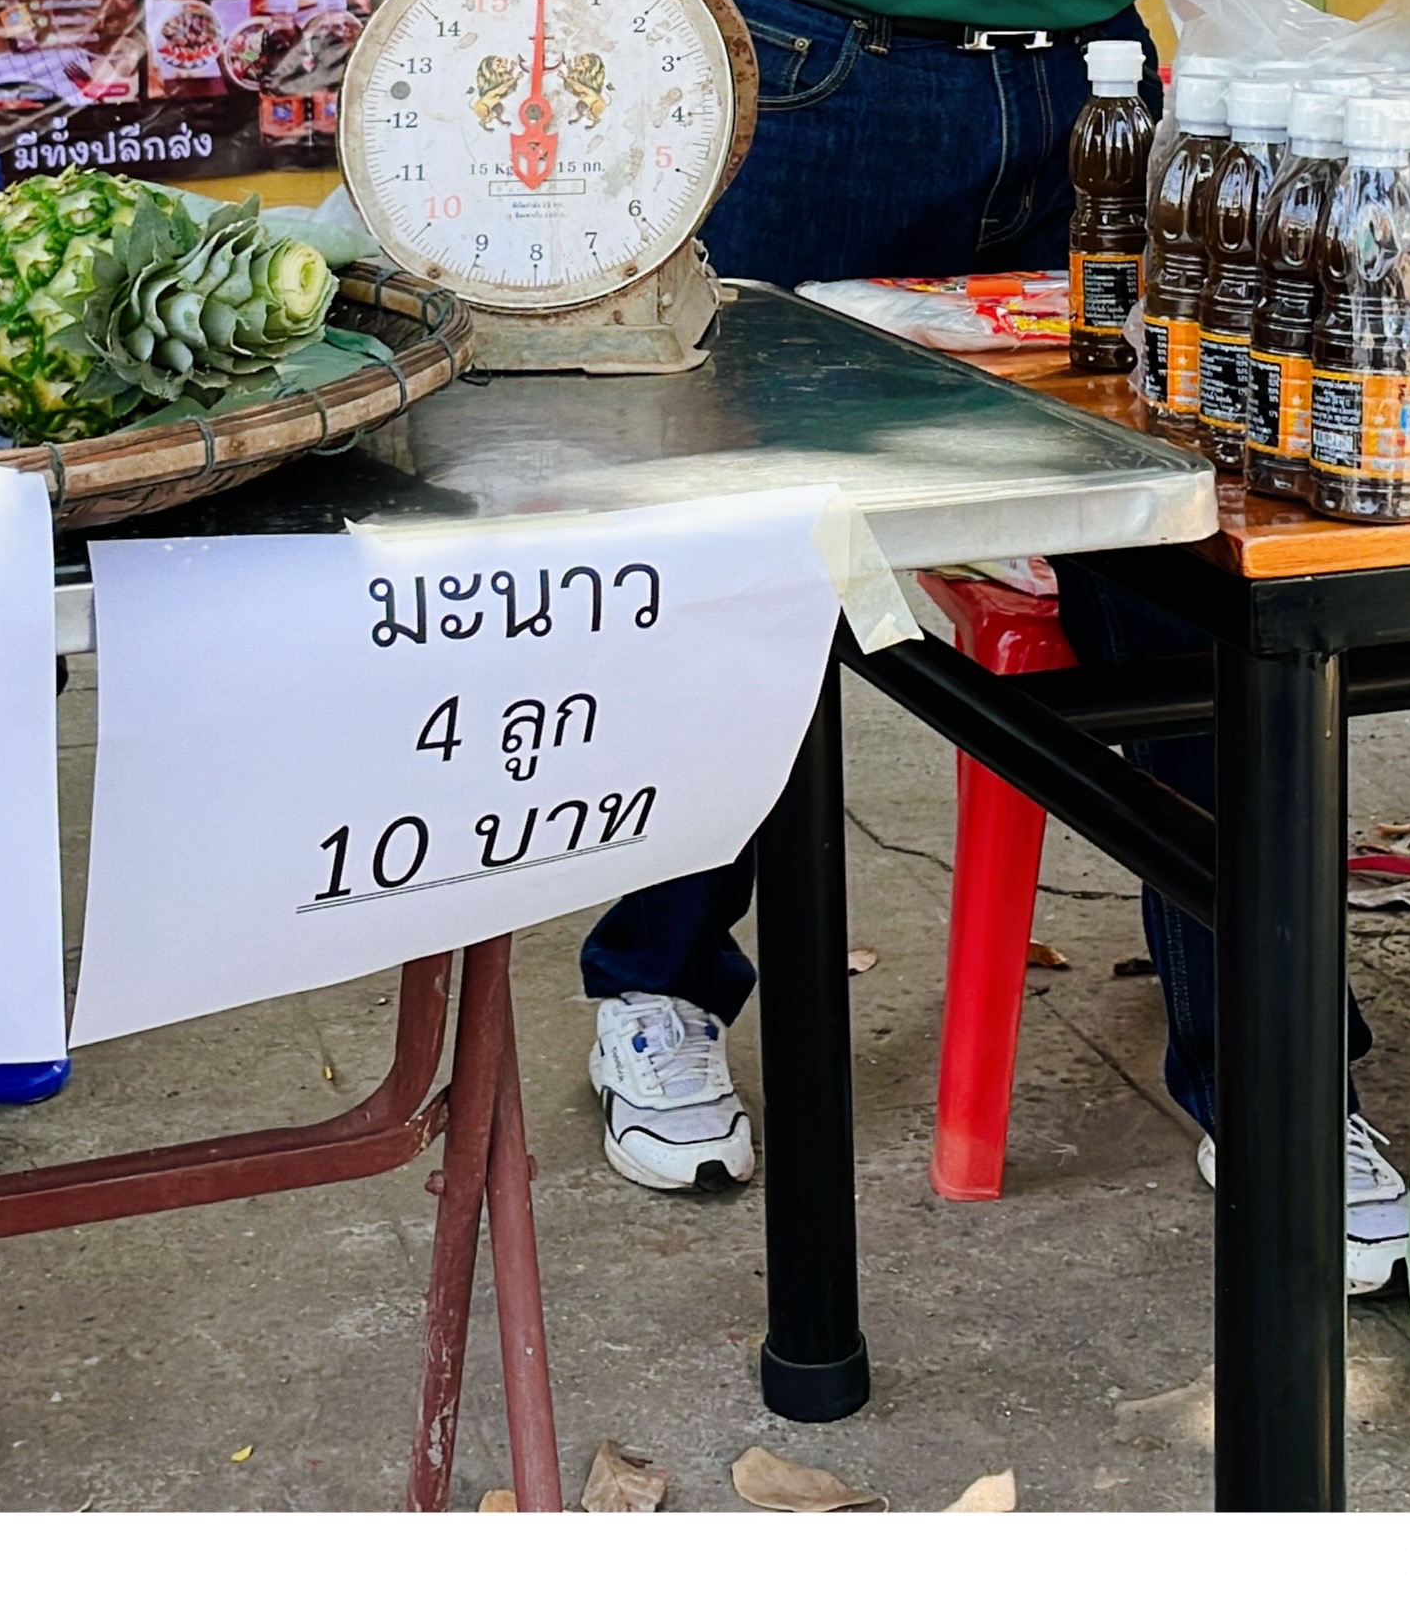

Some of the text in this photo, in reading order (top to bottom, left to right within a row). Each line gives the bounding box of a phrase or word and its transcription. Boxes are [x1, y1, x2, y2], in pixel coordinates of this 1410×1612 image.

[436, 21, 461, 37] 14
[633, 16, 646, 34] 2
[406, 57, 432, 74] 13
[662, 55, 675, 73] 3
[392, 112, 418, 129] 12
[671, 105, 684, 123] 4
[14, 116, 213, 171] มีทั้งปลีกส่ง
[655, 146, 673, 168] 5
[401, 165, 426, 181] 11
[470, 163, 488, 175] 15
[558, 162, 577, 173] 15
[425, 196, 463, 219] 10
[628, 200, 642, 218] 6
[476, 233, 489, 252] 9
[585, 232, 598, 249] 7
[529, 244, 543, 261] 8
[368, 562, 661, 649] มะนาว
[415, 692, 598, 783] 4 ลูก
[313, 785, 658, 901] 10 บาท
